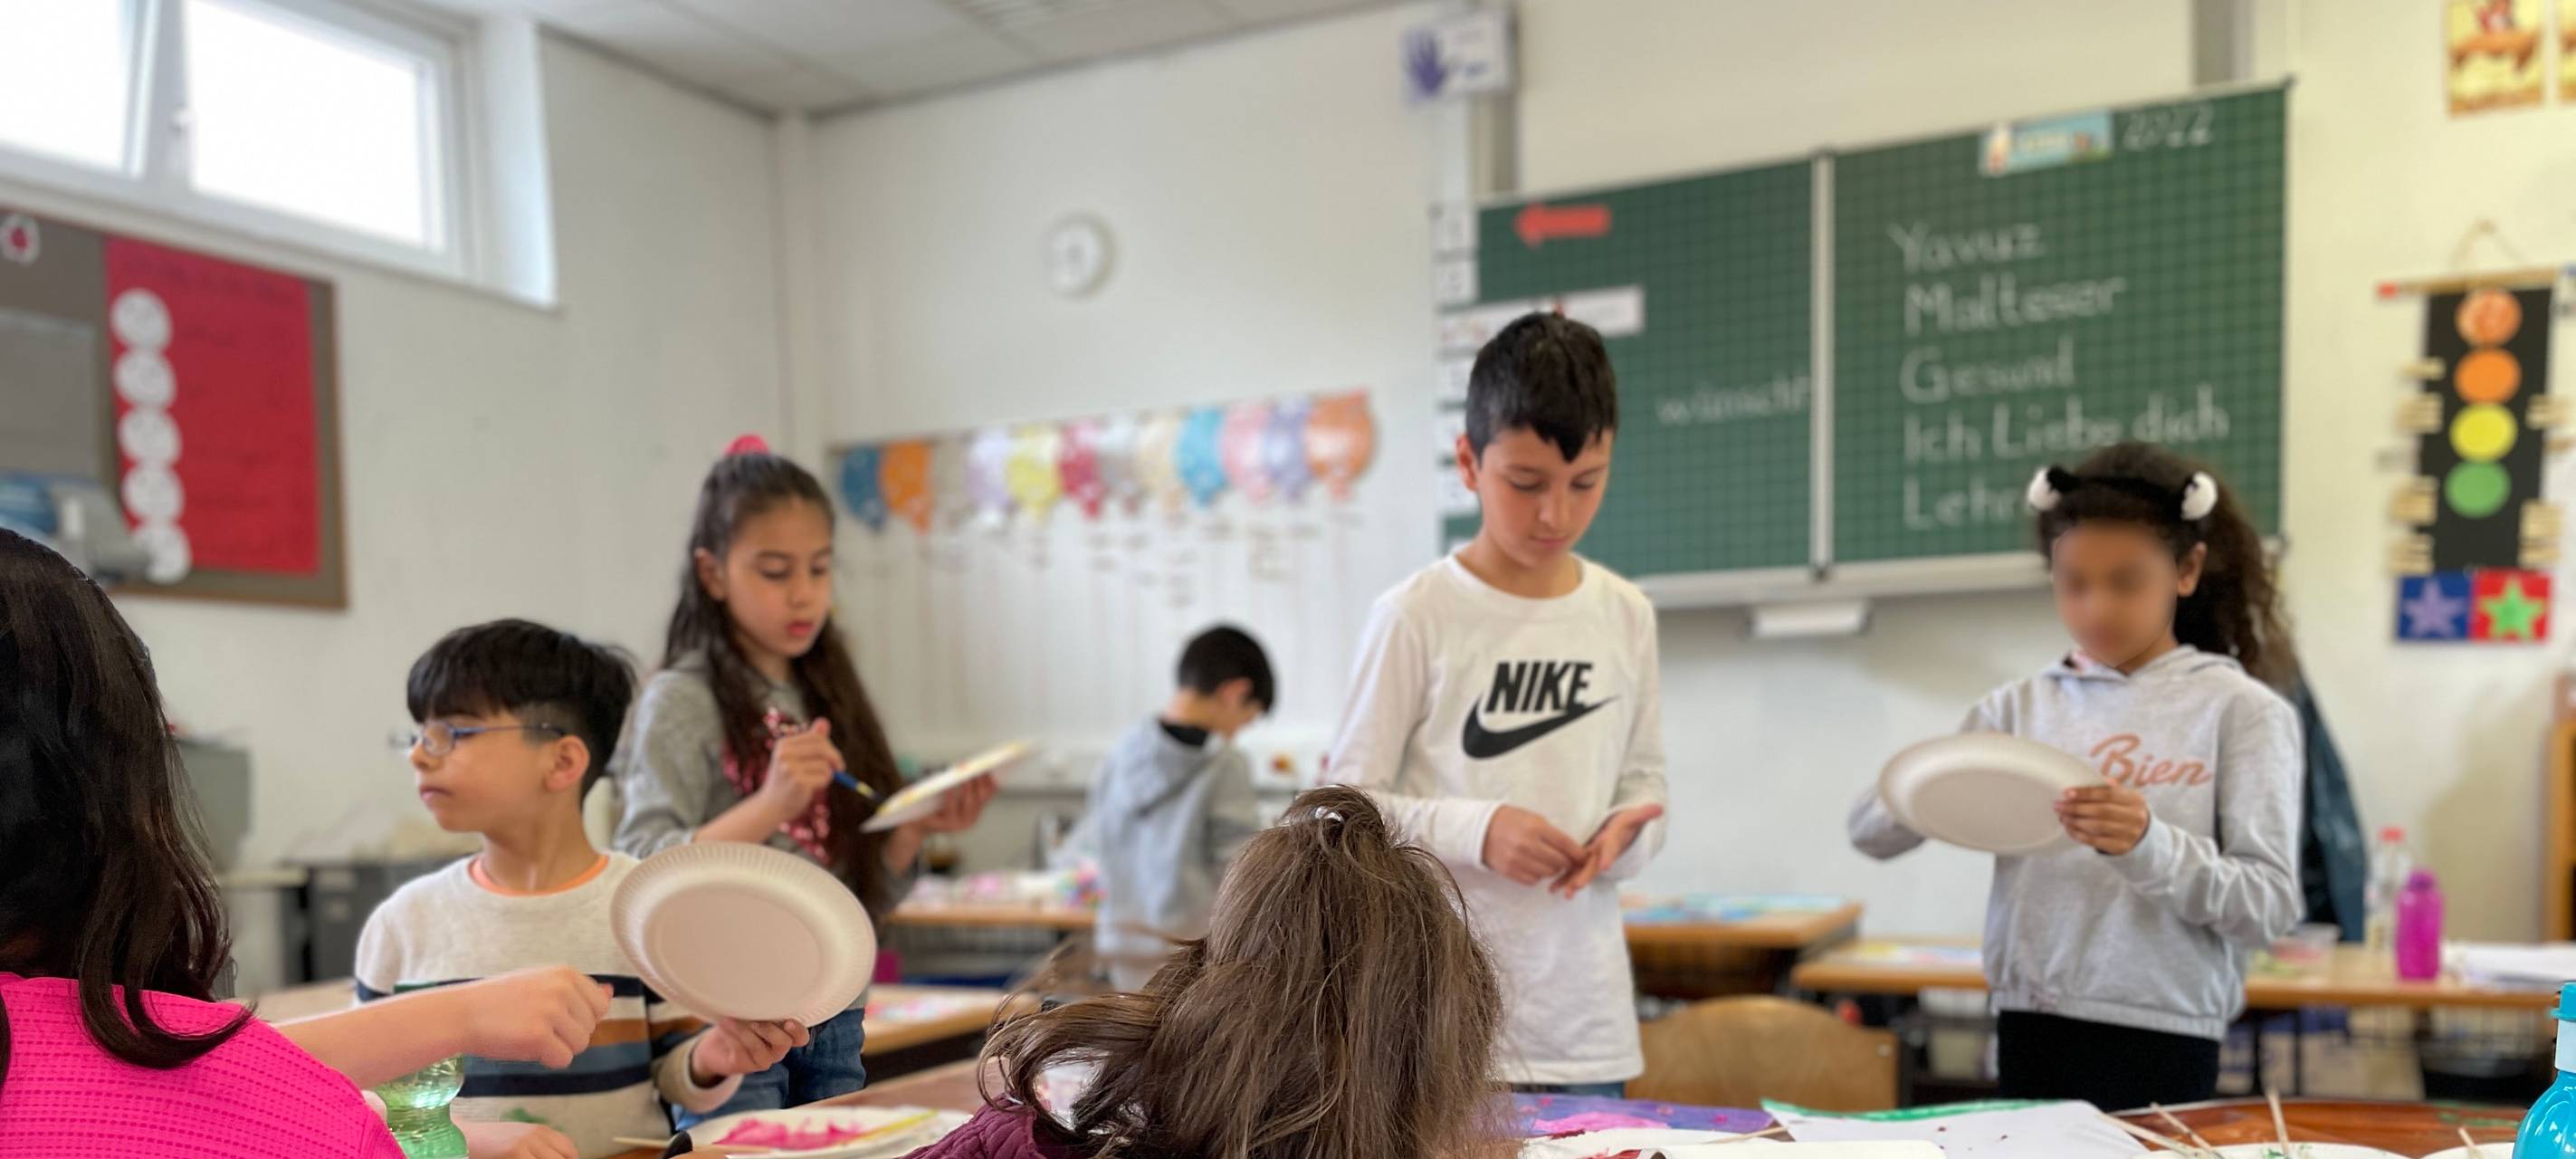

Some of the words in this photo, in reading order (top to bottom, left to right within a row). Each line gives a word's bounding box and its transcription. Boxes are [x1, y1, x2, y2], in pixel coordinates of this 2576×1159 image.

[1902, 337, 2075, 402] Gesund
[1904, 414, 1981, 462] Ich
[2132, 384, 2230, 444] dich
[1903, 475, 2037, 529] Lehr
[1485, 661, 1593, 714] NIKE
[2089, 733, 2214, 788] Bien
